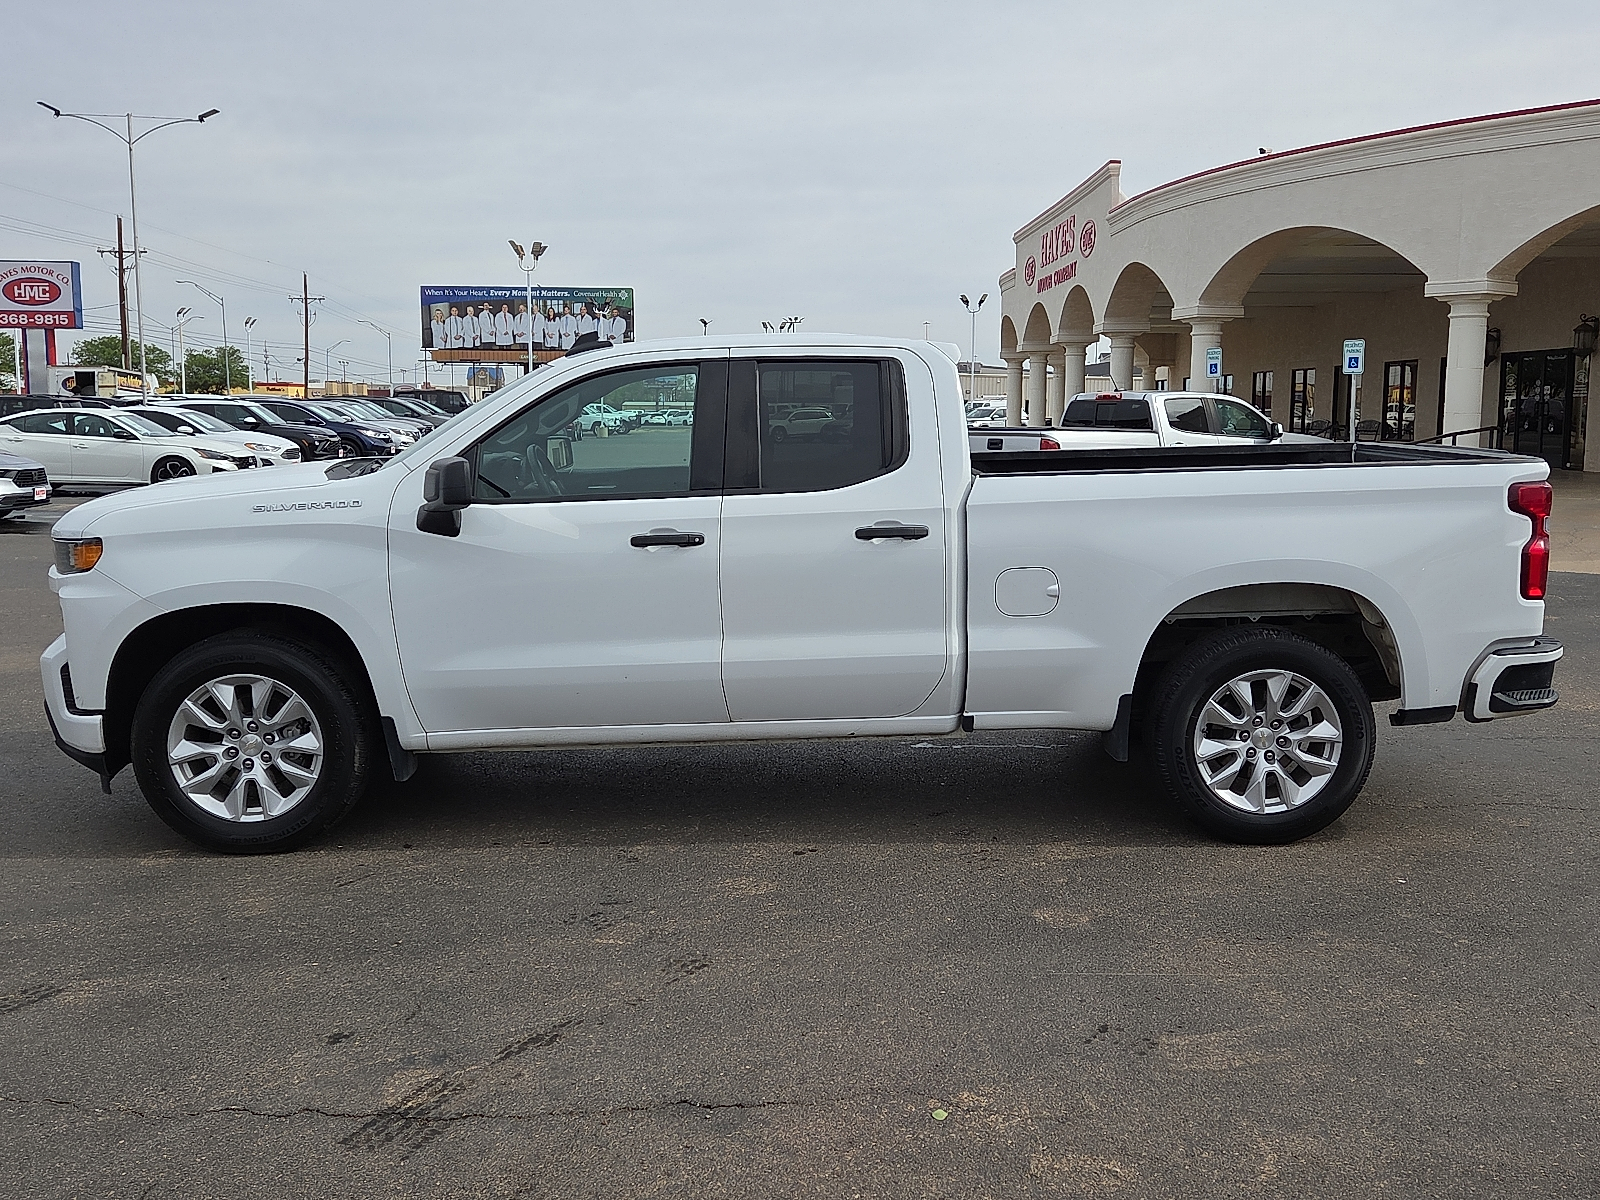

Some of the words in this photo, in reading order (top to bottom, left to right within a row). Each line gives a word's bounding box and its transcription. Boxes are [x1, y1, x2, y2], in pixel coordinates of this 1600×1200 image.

[1040, 214, 1076, 268] HAYES
[20, 265, 55, 278] MOTOR
[56, 273, 70, 287] CO.
[14, 282, 51, 301] HMC
[469, 289, 488, 297] Heart,
[489, 289, 510, 298] Every
[511, 289, 540, 297] Momnt
[0, 313, 69, 325] 368-9815
[252, 500, 362, 512] SILVERADO
